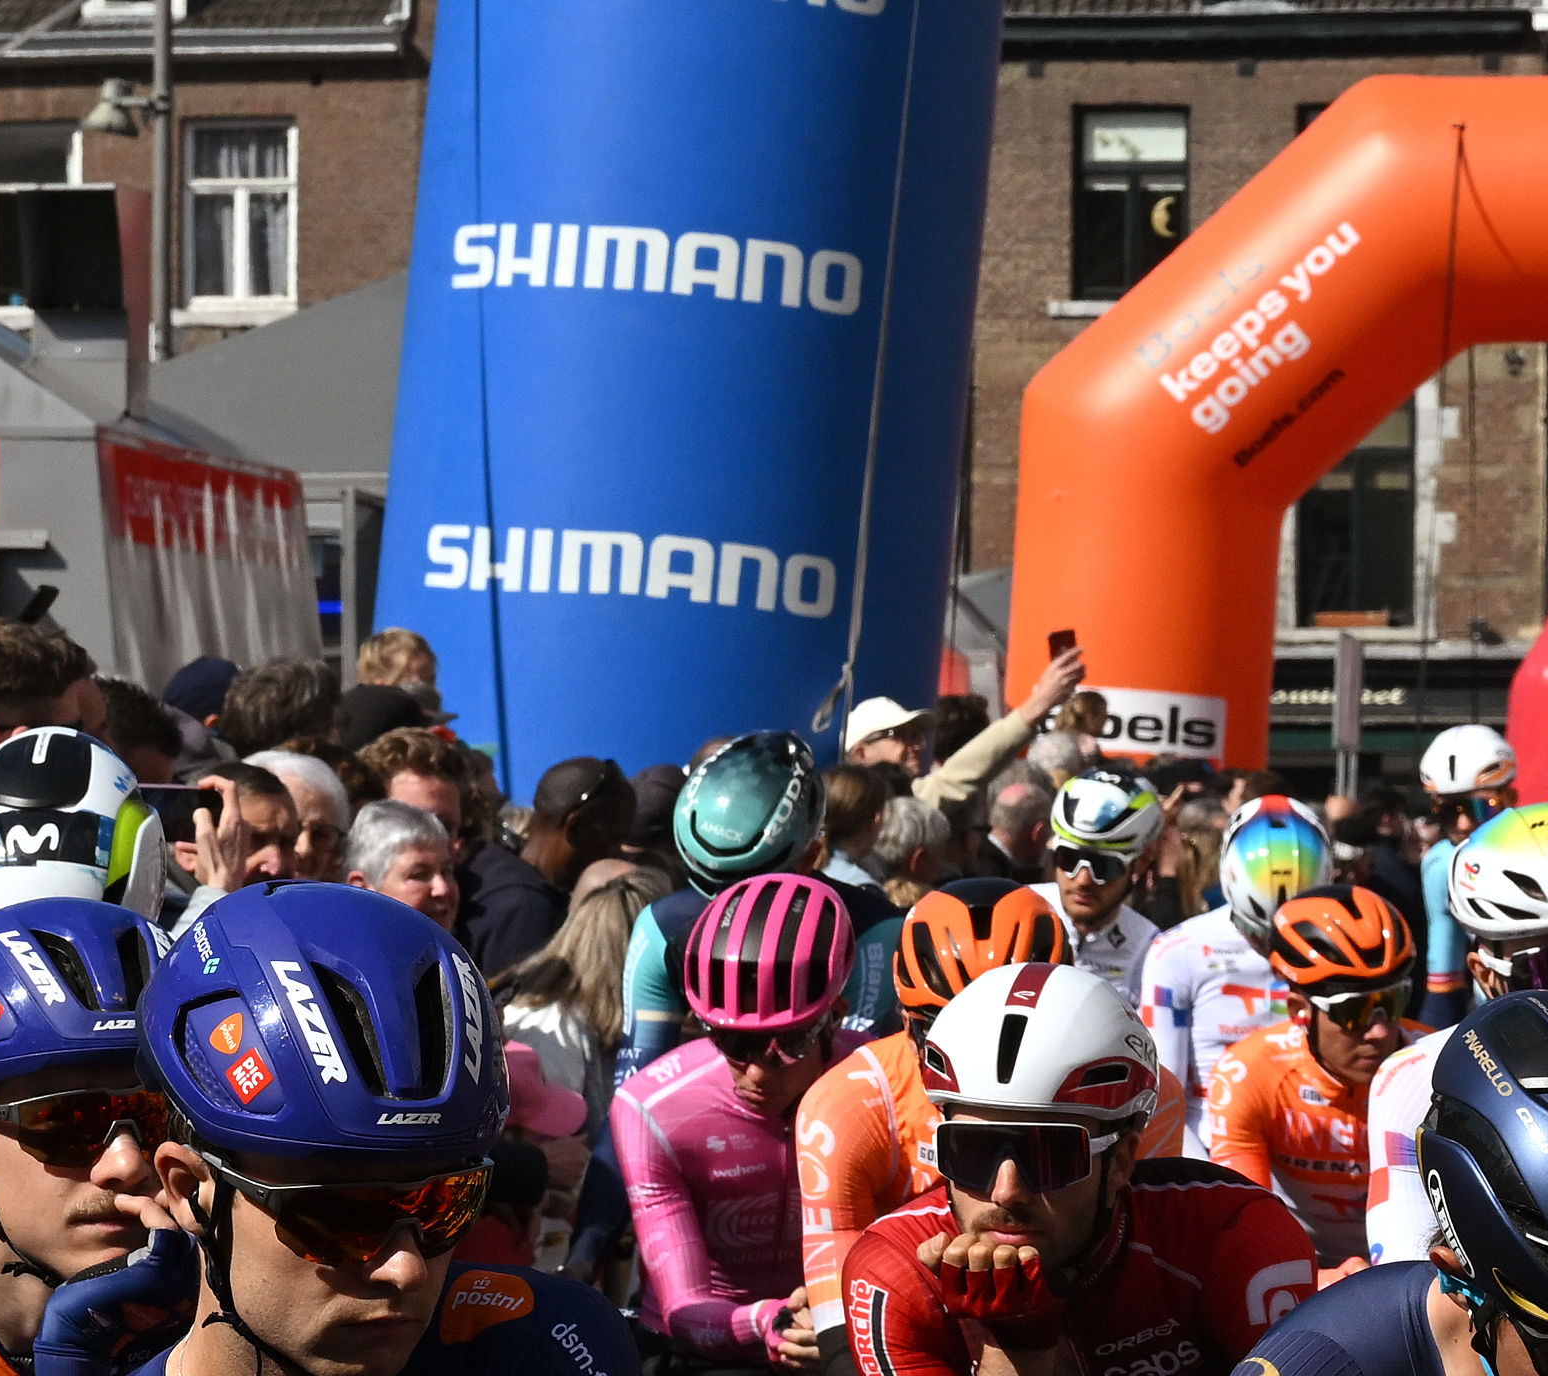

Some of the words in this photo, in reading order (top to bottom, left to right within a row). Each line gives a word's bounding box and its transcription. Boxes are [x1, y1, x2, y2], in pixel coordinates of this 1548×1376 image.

[451, 220, 863, 315] SHIMANO
[1158, 284, 1289, 404] keeps
[1278, 221, 1362, 303] you
[1188, 321, 1313, 435] going
[426, 523, 837, 619] SHIMANO
[1042, 704, 1218, 747] oels
[271, 959, 349, 1086] LAZER
[452, 951, 482, 1084] LAZER
[1461, 1028, 1514, 1099] PINARELLO
[378, 1110, 443, 1127] LAZER
[452, 1285, 526, 1314] postnl
